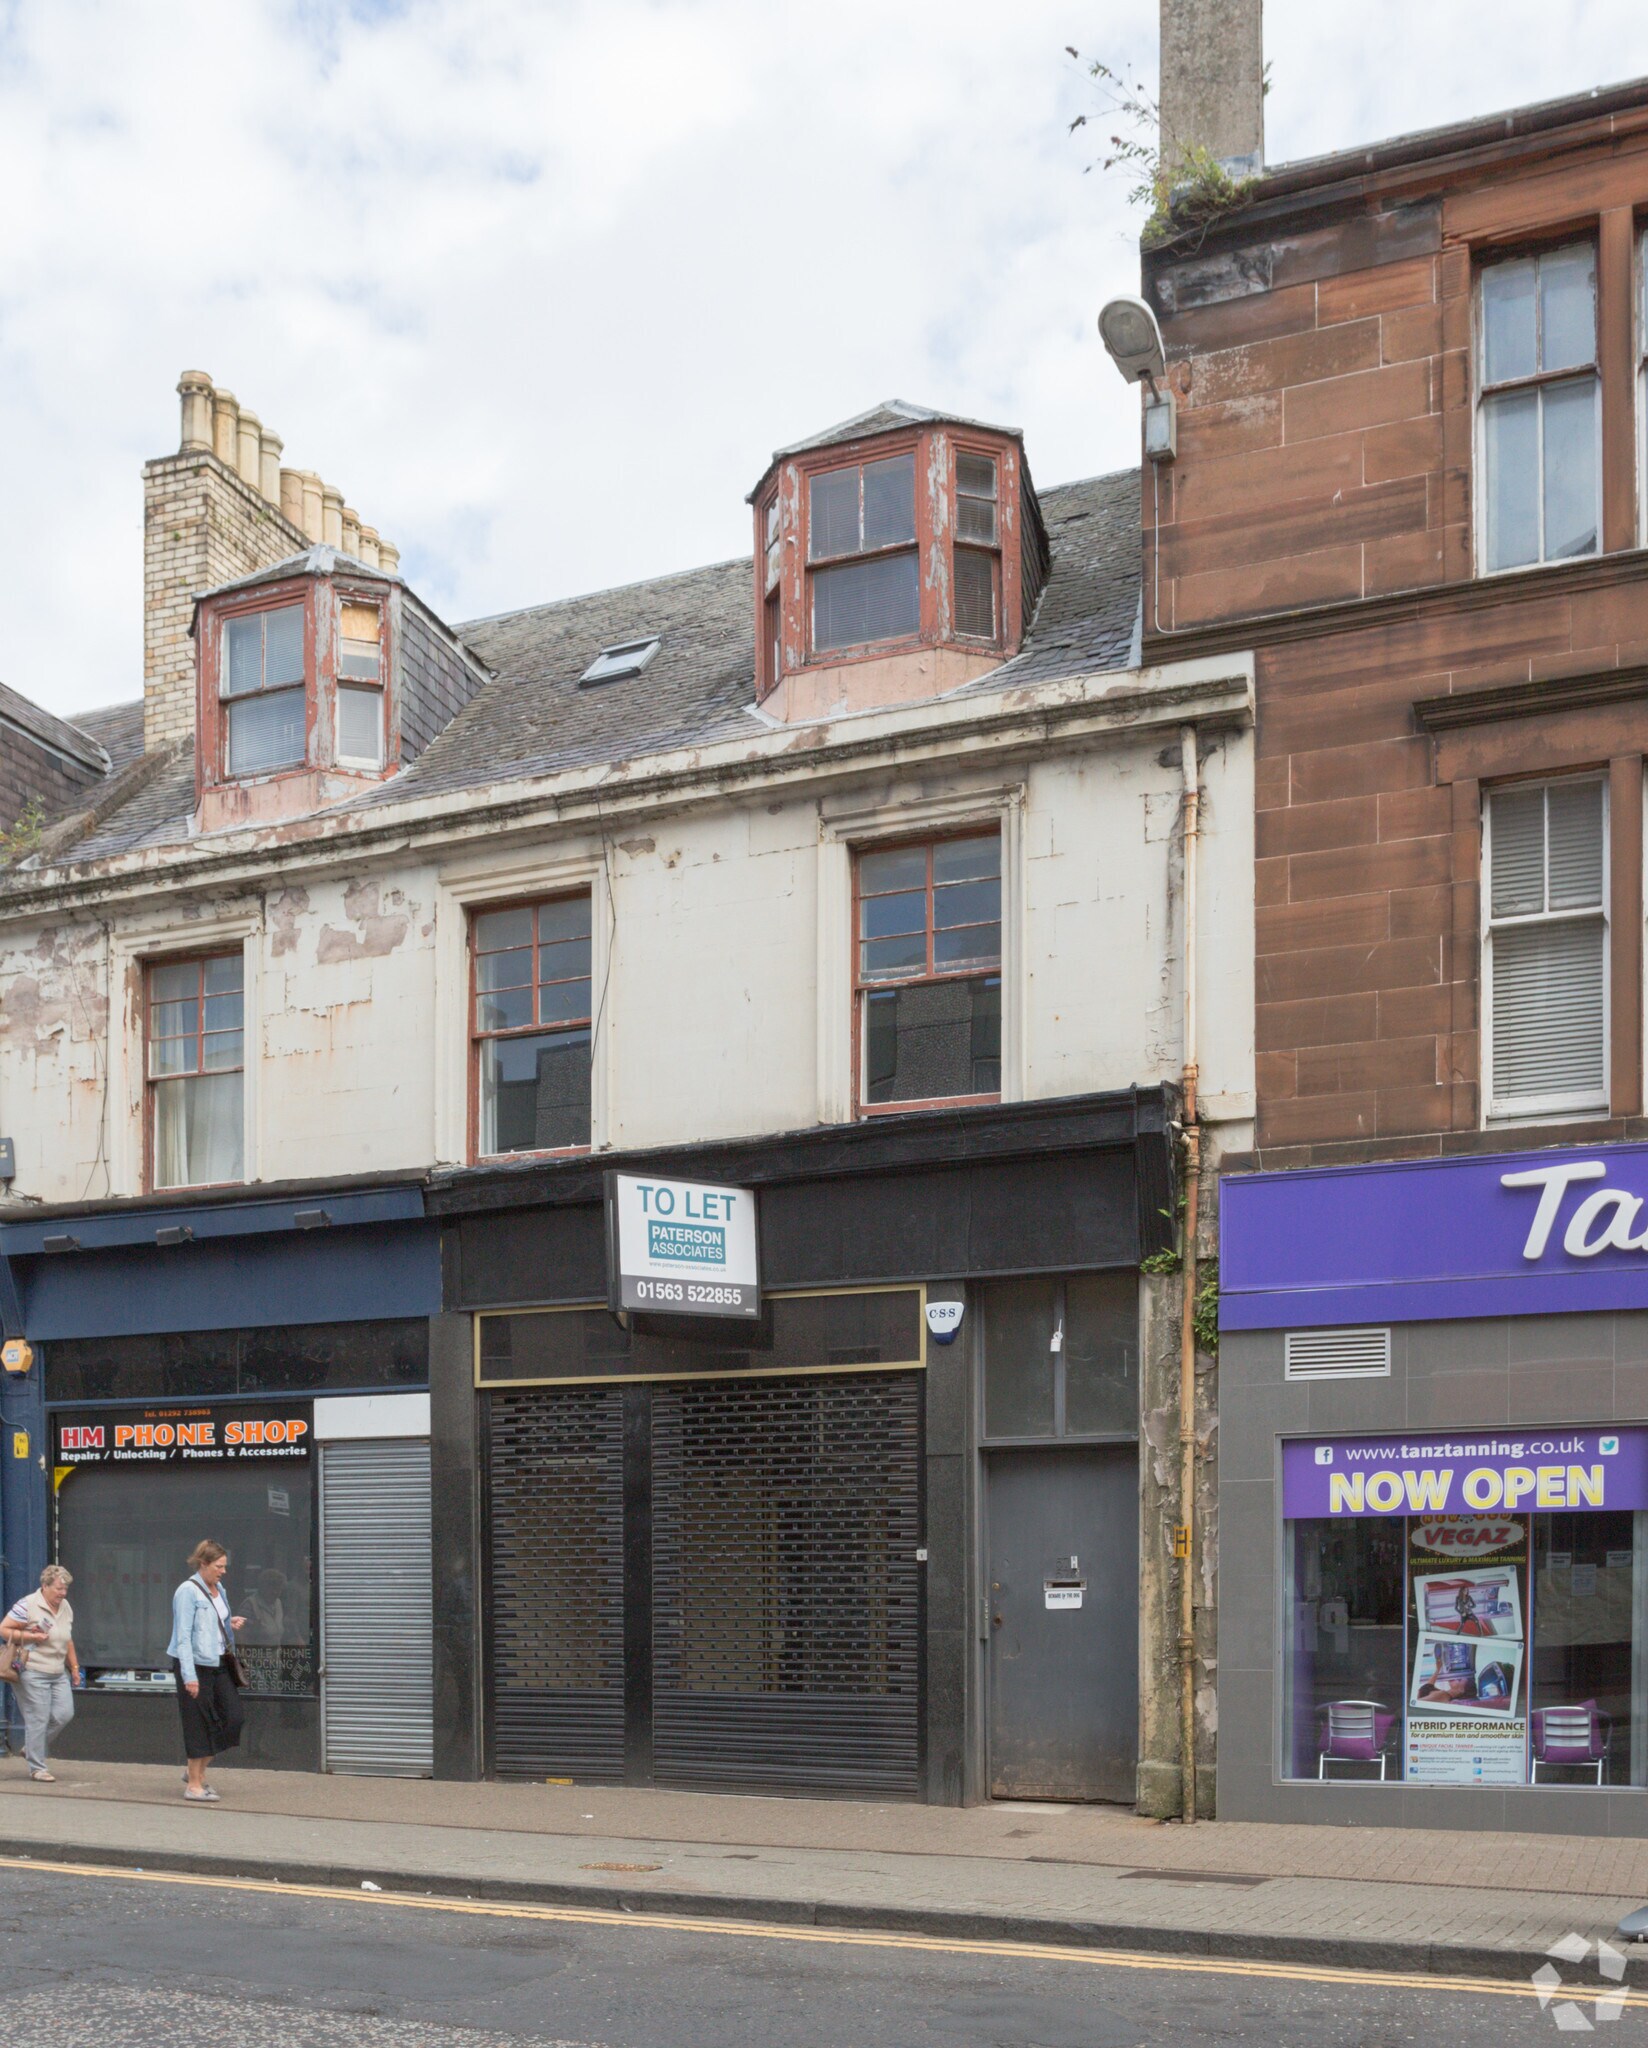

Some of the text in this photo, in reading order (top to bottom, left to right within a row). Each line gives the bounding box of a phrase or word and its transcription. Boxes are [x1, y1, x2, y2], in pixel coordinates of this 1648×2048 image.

[637, 1185, 736, 1221] TO LET
[1501, 1161, 1648, 1259] Ta
[651, 1225, 722, 1245] PATERSON
[651, 1242, 723, 1260] ASSOCIATES
[637, 1281, 742, 1305] 01563 522855
[61, 1420, 308, 1449] HM PHONE SHOP
[60, 1451, 101, 1462] Repairs
[113, 1449, 167, 1460] Unlocking
[182, 1448, 223, 1458] Phones
[227, 1447, 235, 1457] &
[239, 1445, 307, 1457] Accessories
[1345, 1437, 1585, 1461] www.tanztanning.co.uk
[1330, 1465, 1604, 1513] NOW OPEN
[1424, 1527, 1511, 1547] VEGAZ
[1410, 1557, 1438, 1565] ULTIMATE
[1500, 1555, 1526, 1563] TANNING
[236, 1648, 312, 1659] MOBILE PHONE
[240, 1659, 293, 1670] NLOCKING
[244, 1669, 279, 1680] EPAIRS
[1409, 1721, 1525, 1731] HYBRID PERFORMANCE
